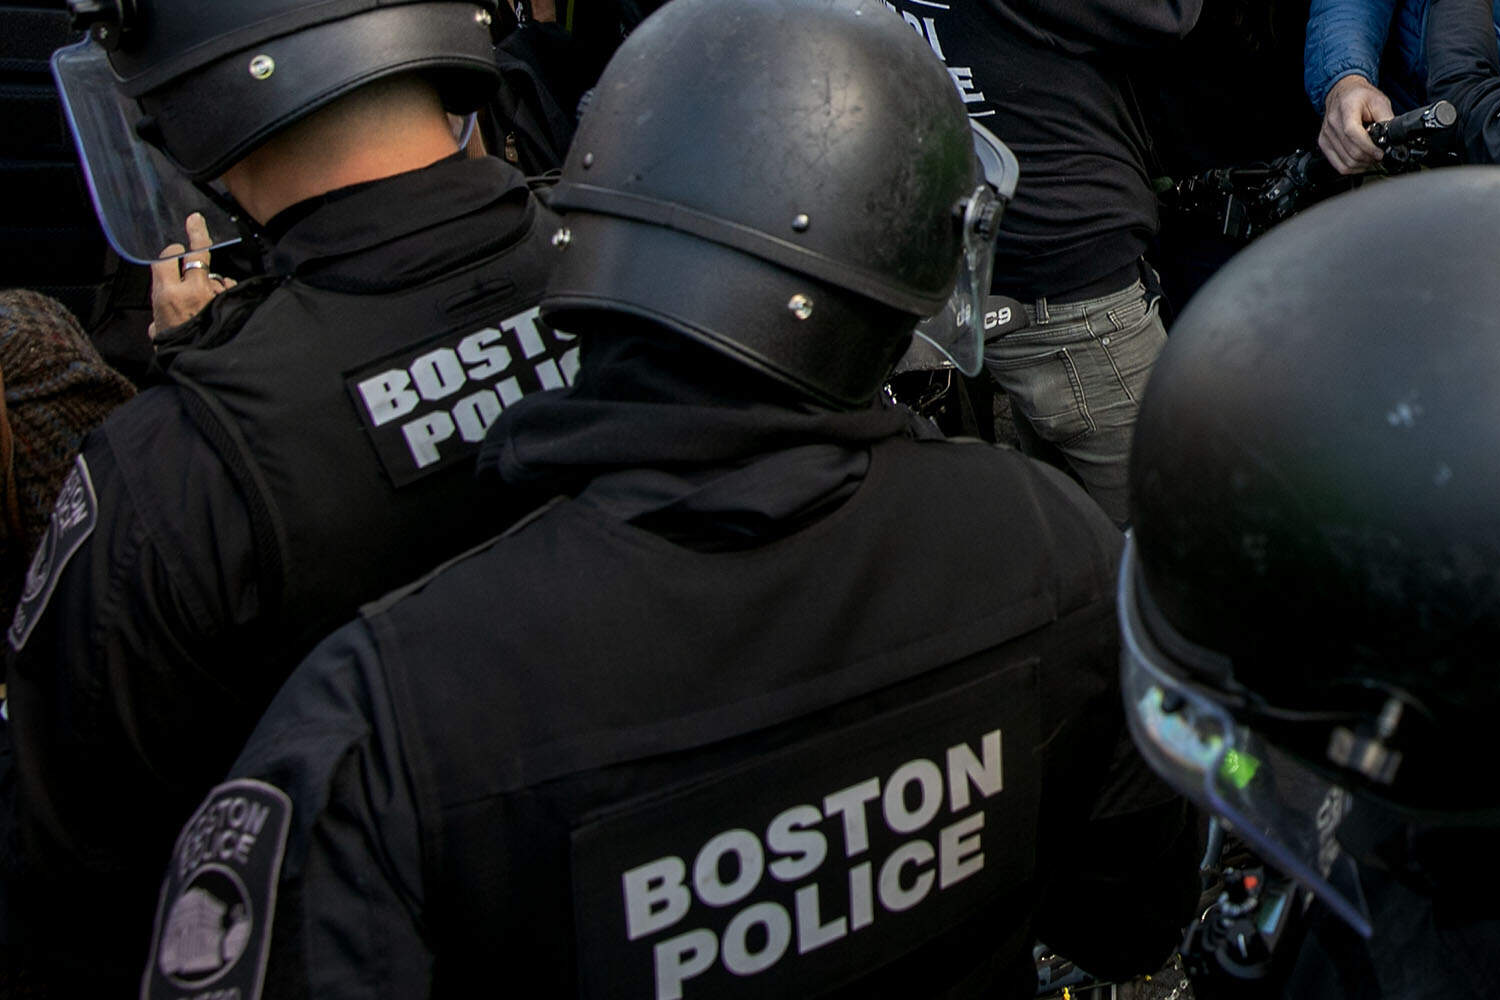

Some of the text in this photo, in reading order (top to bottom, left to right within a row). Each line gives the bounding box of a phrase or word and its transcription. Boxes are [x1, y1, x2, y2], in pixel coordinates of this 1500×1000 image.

[357, 305, 577, 427] BOST
[622, 729, 1003, 941] BOSTON
[653, 810, 985, 1000] POLICE
